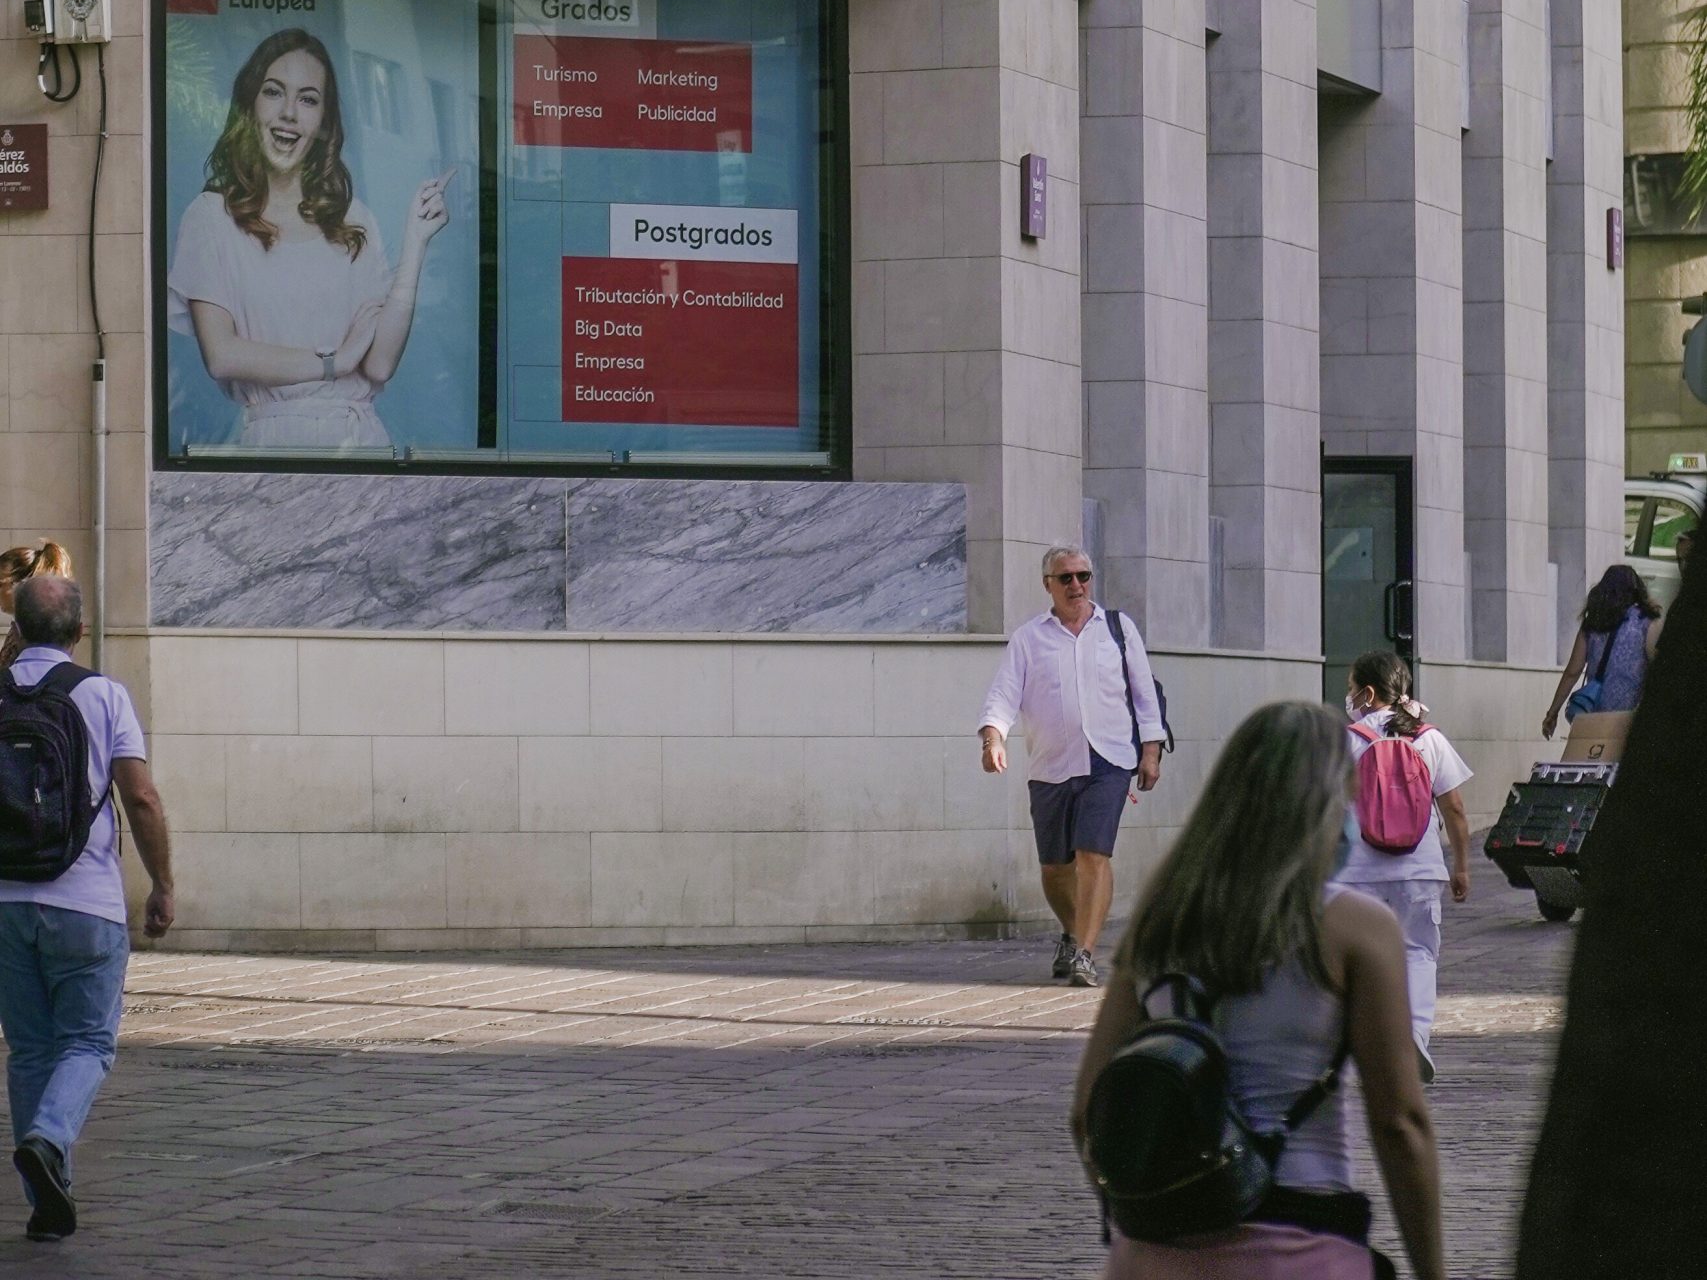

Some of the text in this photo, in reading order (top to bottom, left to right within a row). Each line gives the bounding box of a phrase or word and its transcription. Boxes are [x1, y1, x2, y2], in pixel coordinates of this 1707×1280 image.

[533, 65, 598, 83] Turismo
[638, 69, 718, 91] Marketing
[533, 100, 603, 120] Empresa
[638, 104, 717, 123] Publicidad
[634, 219, 773, 250] Postgrados
[575, 286, 784, 309] Tributación y Contabilidad
[575, 319, 643, 339] Big Data
[575, 352, 645, 372] Empresa
[575, 385, 655, 403] Educación
